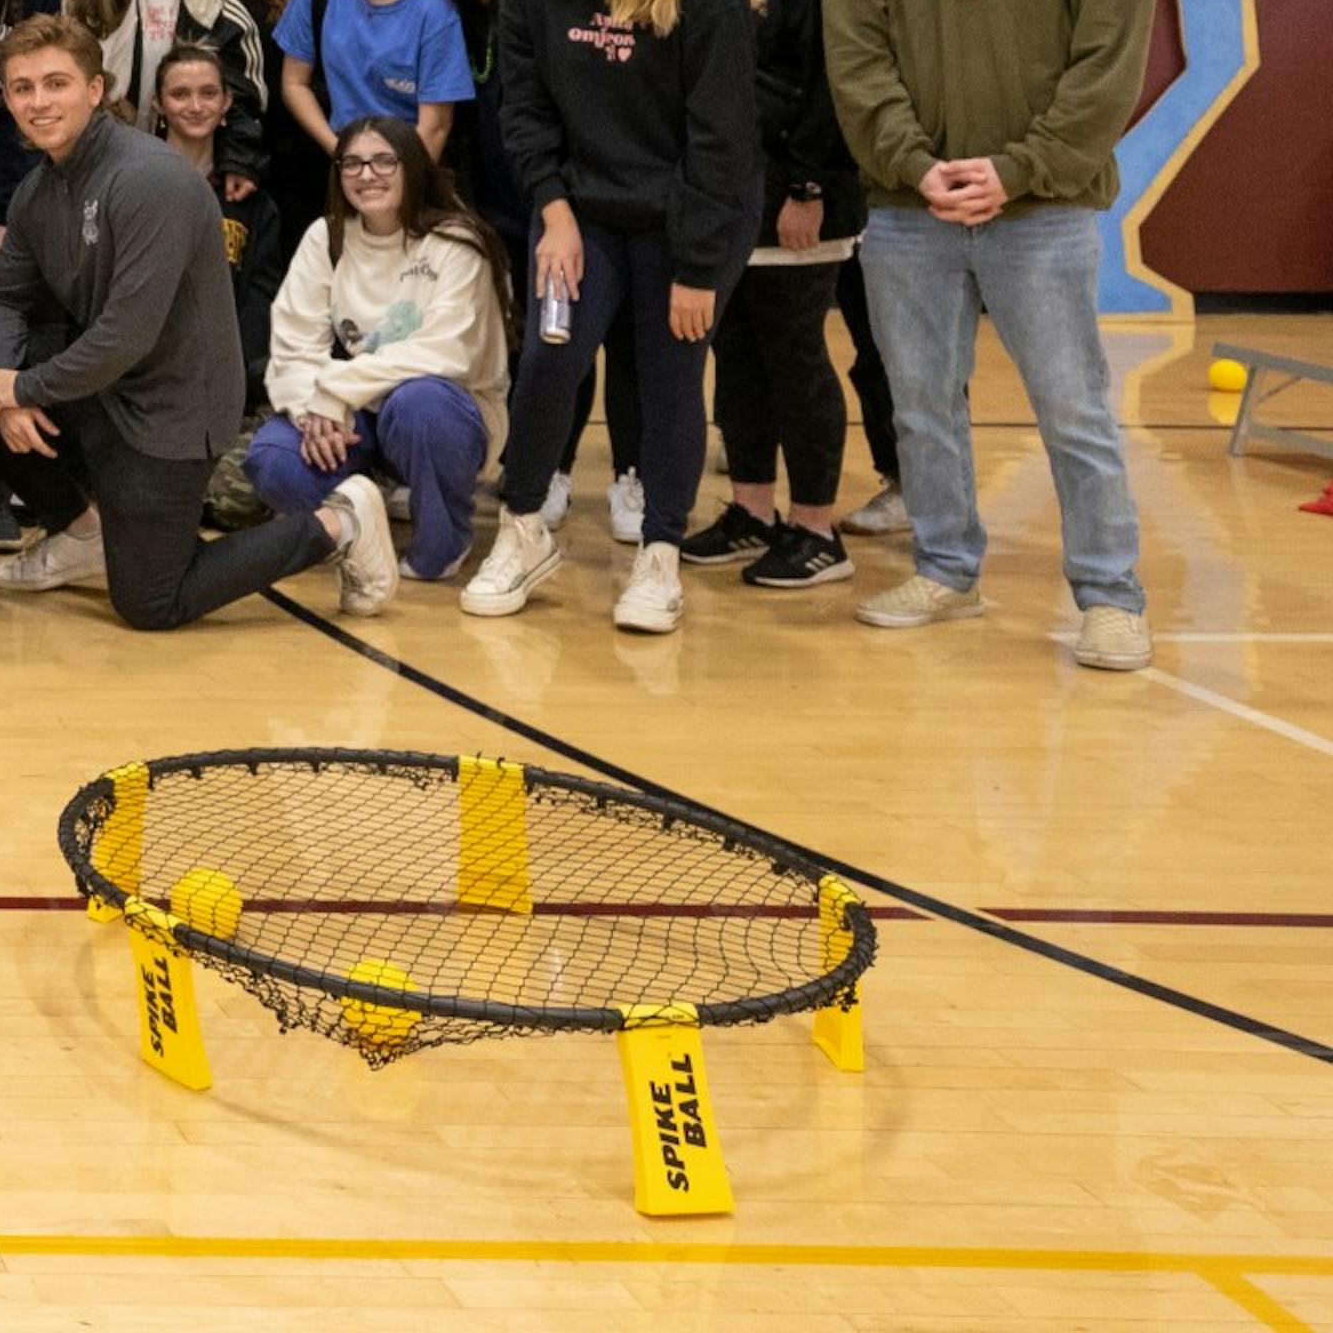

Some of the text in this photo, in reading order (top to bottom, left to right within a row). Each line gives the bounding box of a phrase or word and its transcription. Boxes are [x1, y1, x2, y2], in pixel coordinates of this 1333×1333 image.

[141, 963, 164, 1057] SPIKE
[153, 956, 178, 1034] BALL
[649, 1081, 689, 1192] SPIKE
[670, 1053, 707, 1148] BALL
